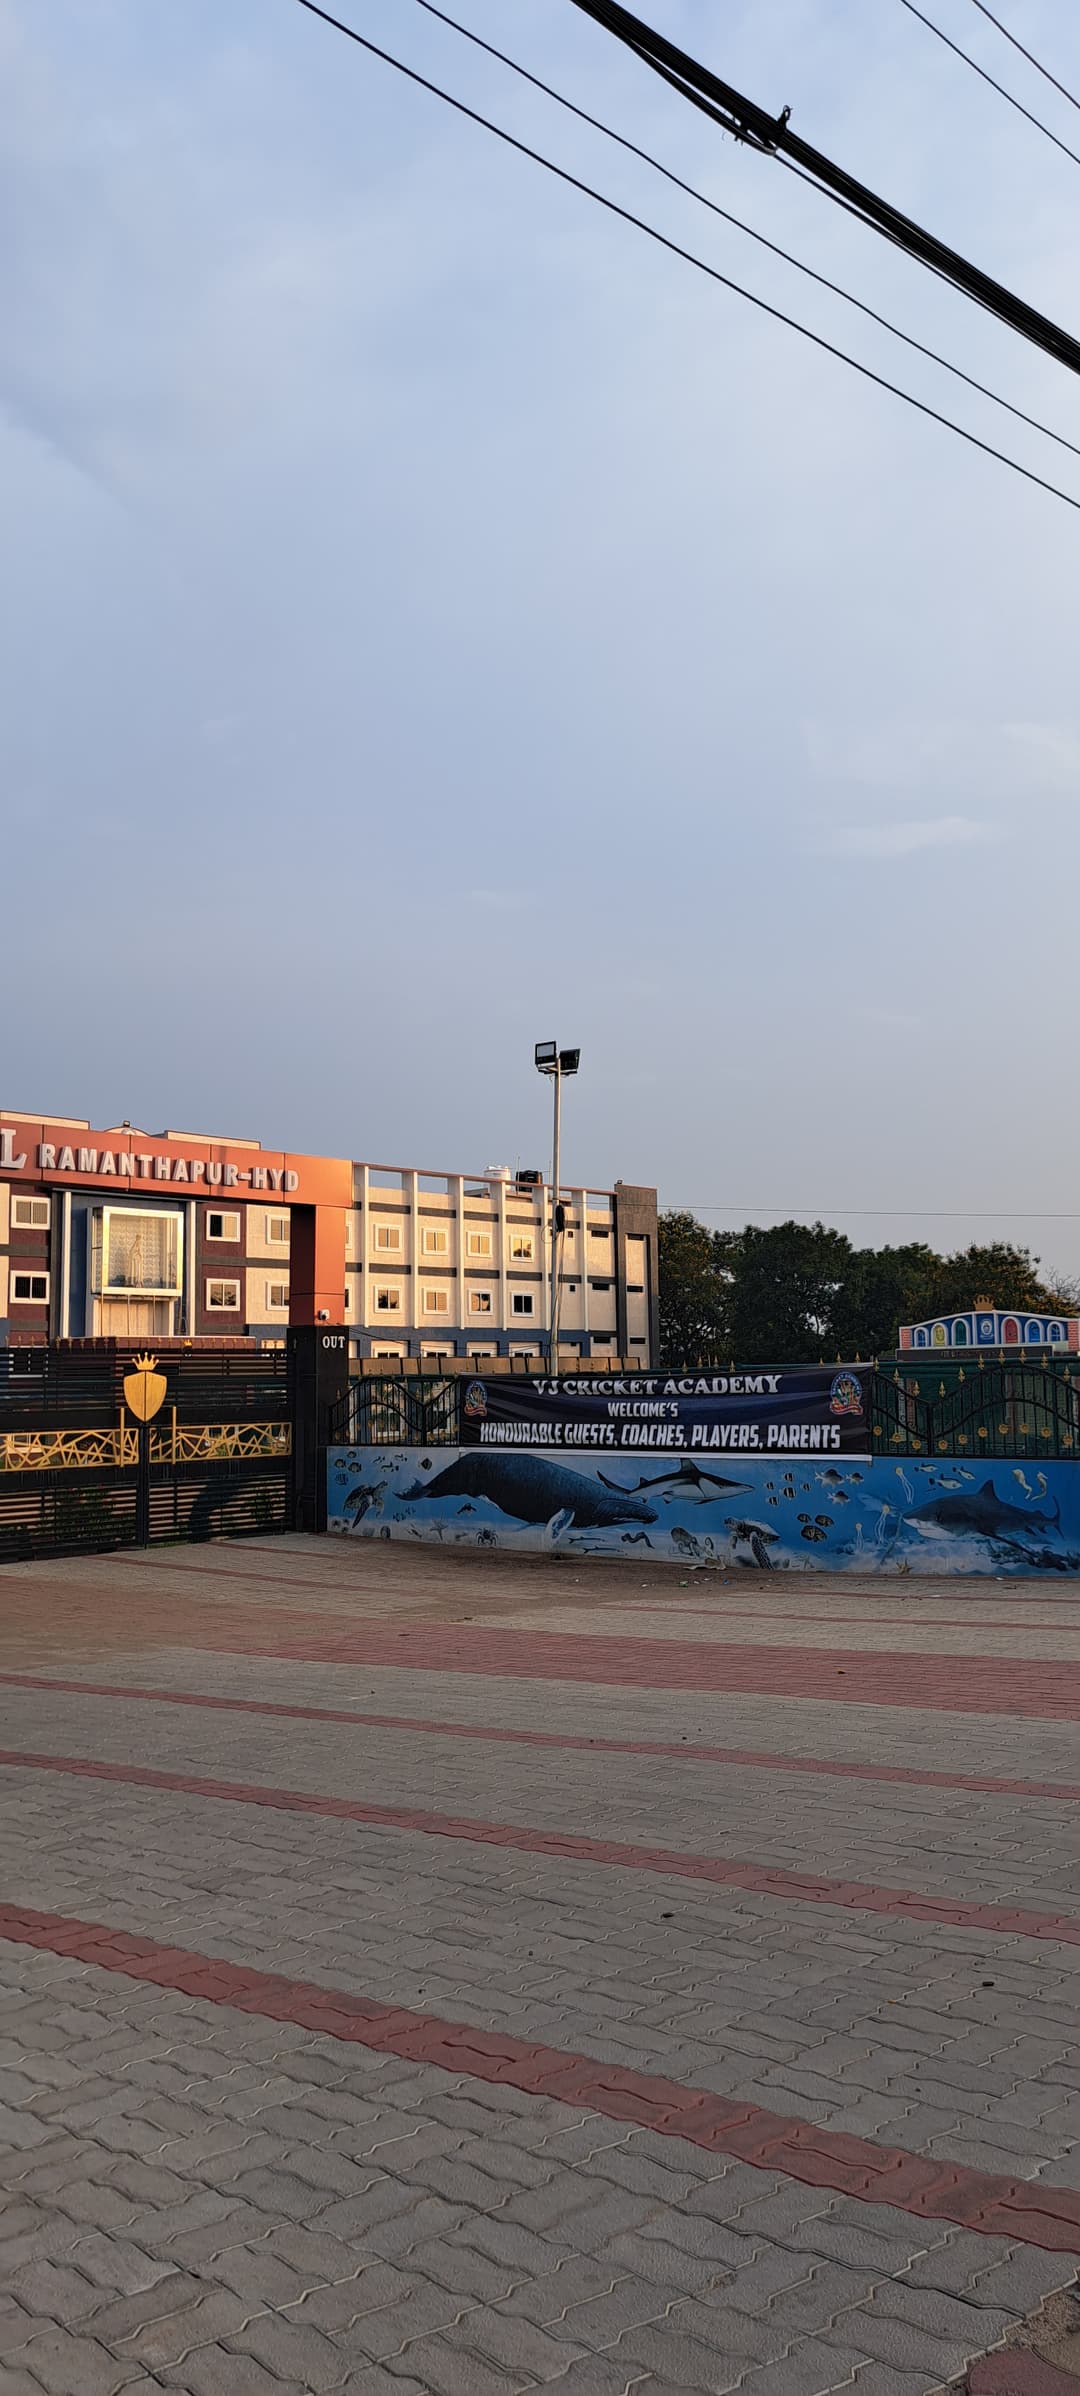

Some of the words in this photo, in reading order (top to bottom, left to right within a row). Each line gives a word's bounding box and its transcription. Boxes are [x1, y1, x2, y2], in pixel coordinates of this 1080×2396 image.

[39, 1143, 299, 1192] RAMANTHAPUR-HYD
[322, 1335, 346, 1350] OUT
[532, 1379, 560, 1396] VJ
[562, 1378, 658, 1395] CRICKET
[663, 1374, 783, 1394] ACADEMY
[607, 1400, 679, 1418] WELCOME'S
[480, 1422, 562, 1444] HONOURABLE
[564, 1423, 618, 1447] GUESTS,
[621, 1424, 688, 1449] COACHES,
[691, 1424, 764, 1450] PLAYERS,
[767, 1424, 841, 1449] PARENTS
